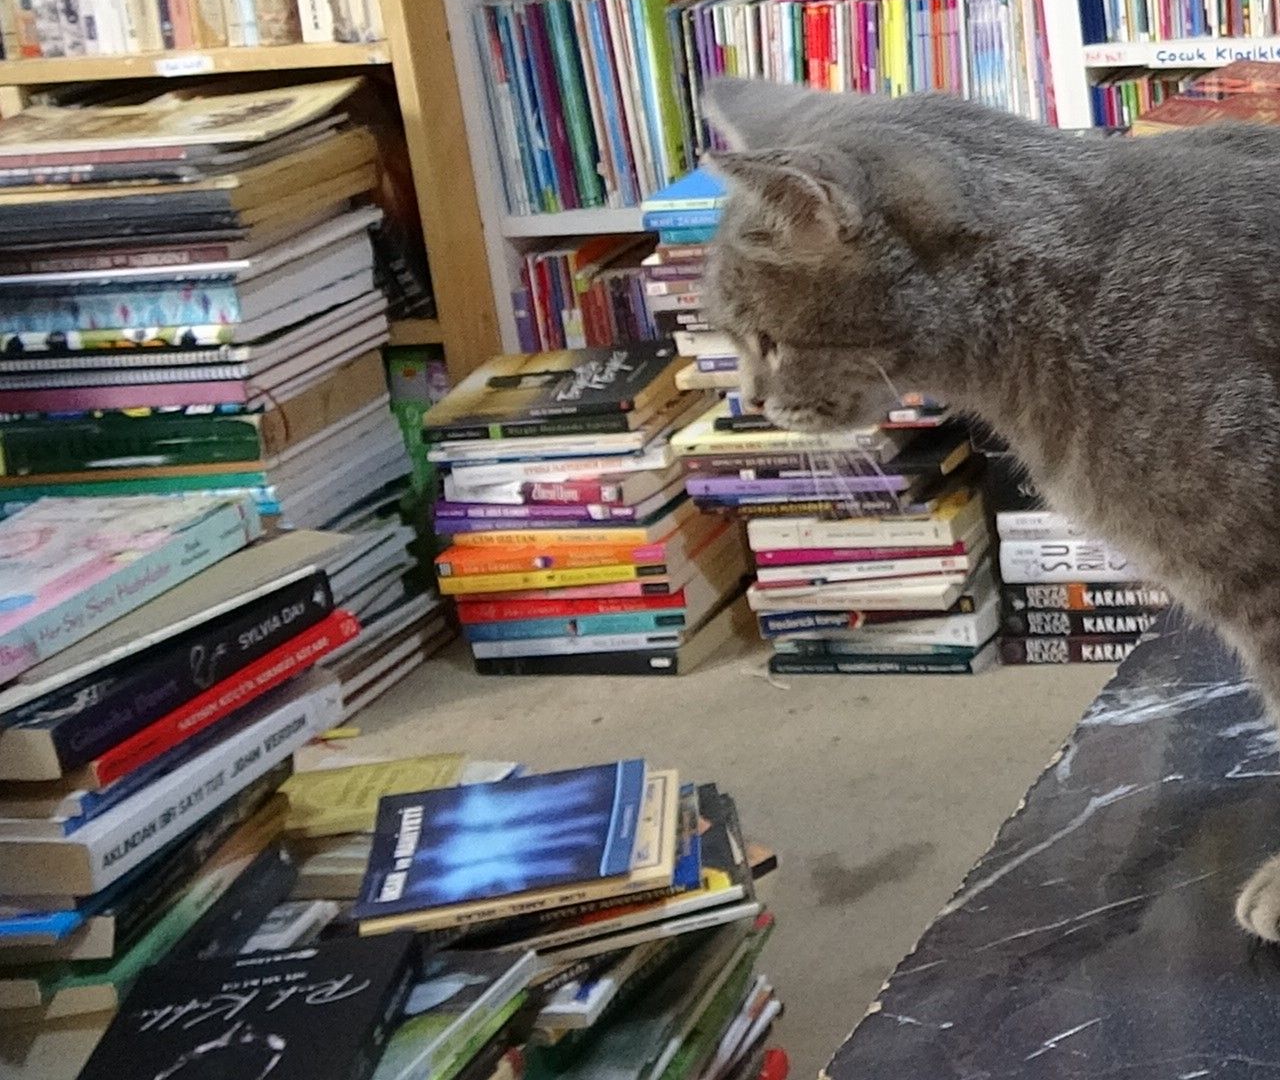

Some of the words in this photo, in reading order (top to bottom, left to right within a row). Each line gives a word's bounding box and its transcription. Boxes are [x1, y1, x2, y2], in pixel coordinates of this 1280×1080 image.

[1156, 48, 1208, 64] Çocuk
[238, 614, 282, 651] SYLVIA
[281, 603, 306, 628] DAY
[102, 821, 160, 869] AKLINDAN
